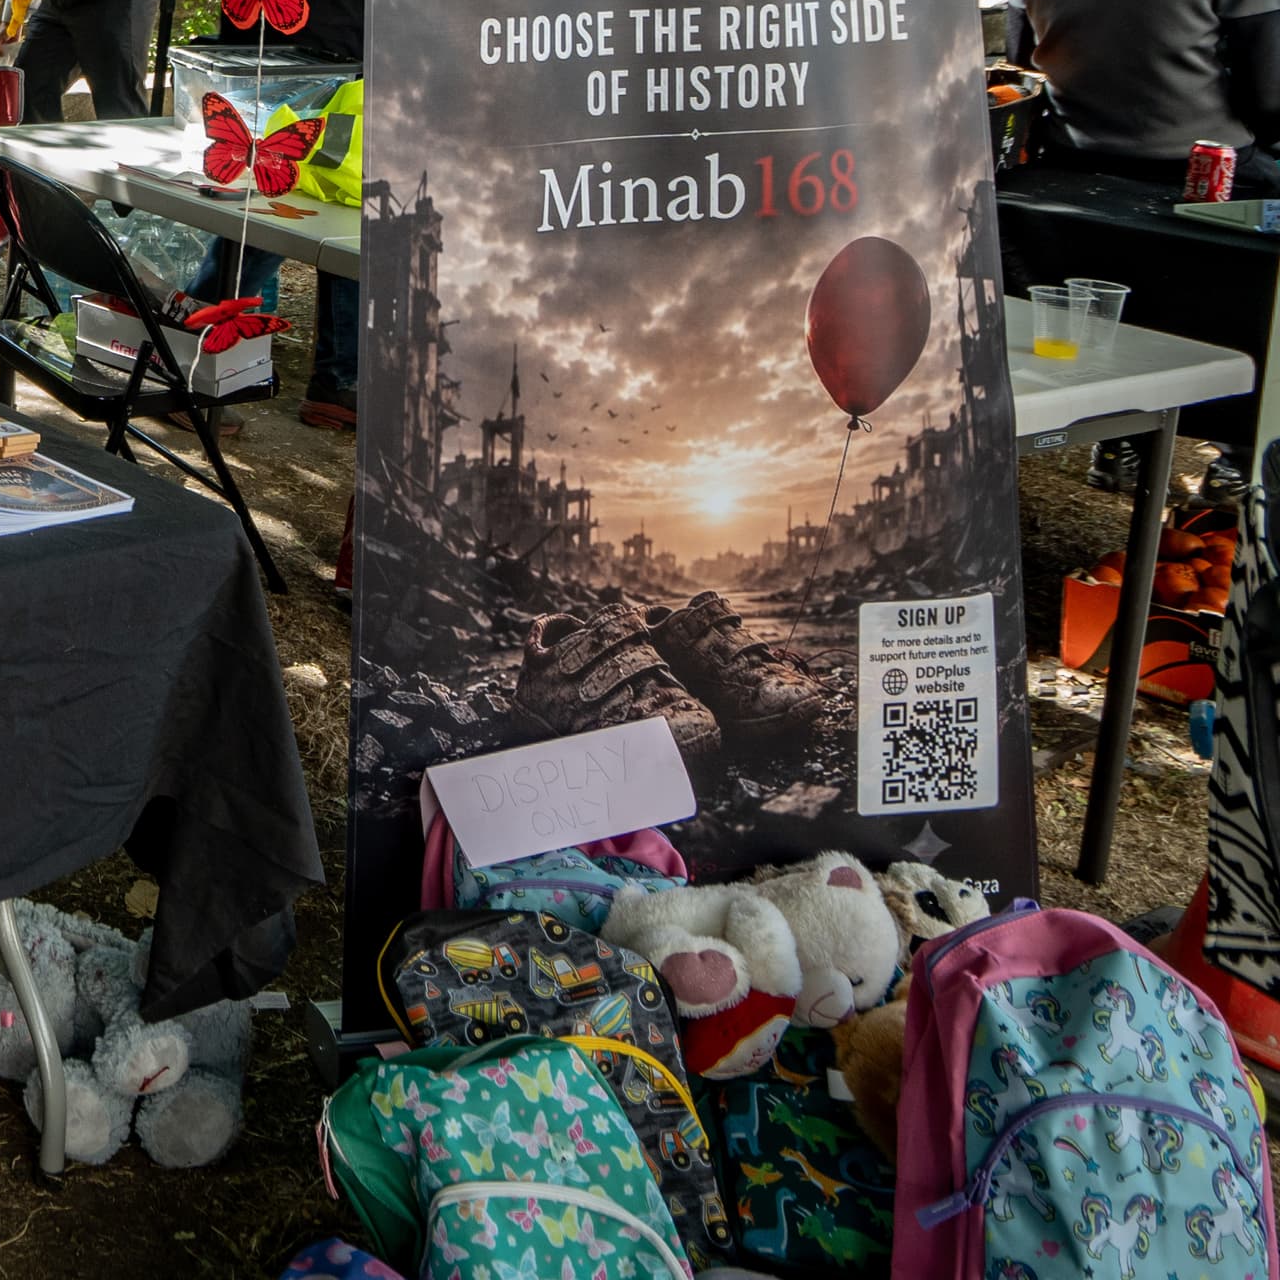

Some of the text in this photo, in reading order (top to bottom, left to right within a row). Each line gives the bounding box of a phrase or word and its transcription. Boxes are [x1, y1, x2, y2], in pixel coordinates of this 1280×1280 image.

[479, 10, 615, 66] CHOOSE
[629, 6, 702, 56] THE
[719, 1, 820, 52] RIGHT
[586, 60, 810, 117] OF HISTORY
[897, 605, 967, 628] SIGN UP
[881, 632, 982, 648] for more details and to
[869, 650, 907, 664] support
[908, 648, 937, 661] future
[938, 647, 969, 658] events
[915, 665, 971, 681] DDPplus
[915, 680, 965, 695] website
[471, 738, 631, 814] DISPLAY
[531, 792, 614, 838] ONLY
